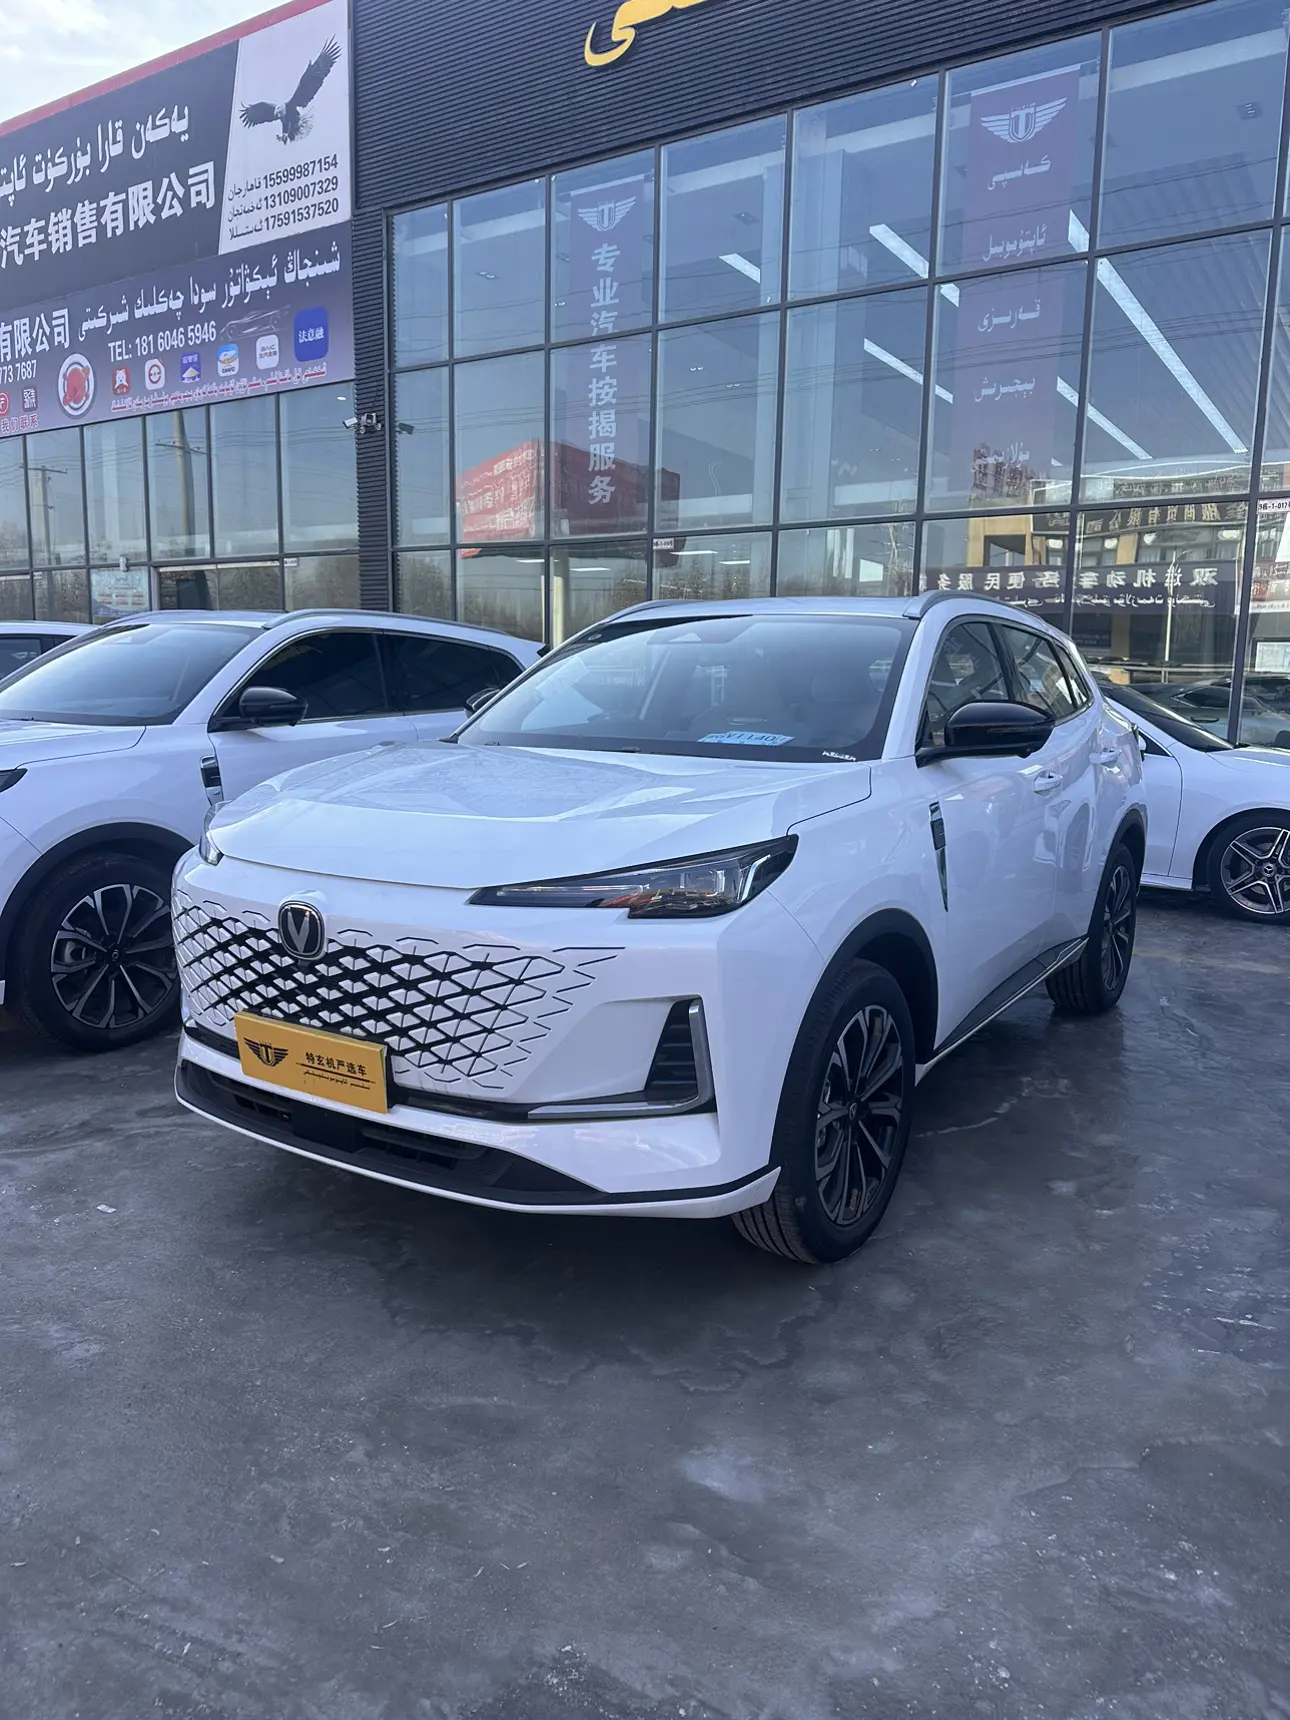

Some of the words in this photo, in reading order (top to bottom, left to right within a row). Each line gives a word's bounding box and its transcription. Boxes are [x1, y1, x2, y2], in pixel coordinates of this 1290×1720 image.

[263, 153, 338, 189] 15599987154
[264, 175, 338, 210] 13109007329
[0, 161, 215, 269] 汽车销售有限公司
[264, 197, 339, 231] 17591537520
[190, 276, 216, 313] سودا
[0, 308, 70, 362] 有限公司
[108, 340, 132, 362] TEL:
[135, 334, 154, 356] 181
[158, 327, 185, 352] 6046
[188, 320, 216, 346] 5946
[15, 359, 37, 382] 7687
[588, 243, 621, 505] 专业汽车按揭服务
